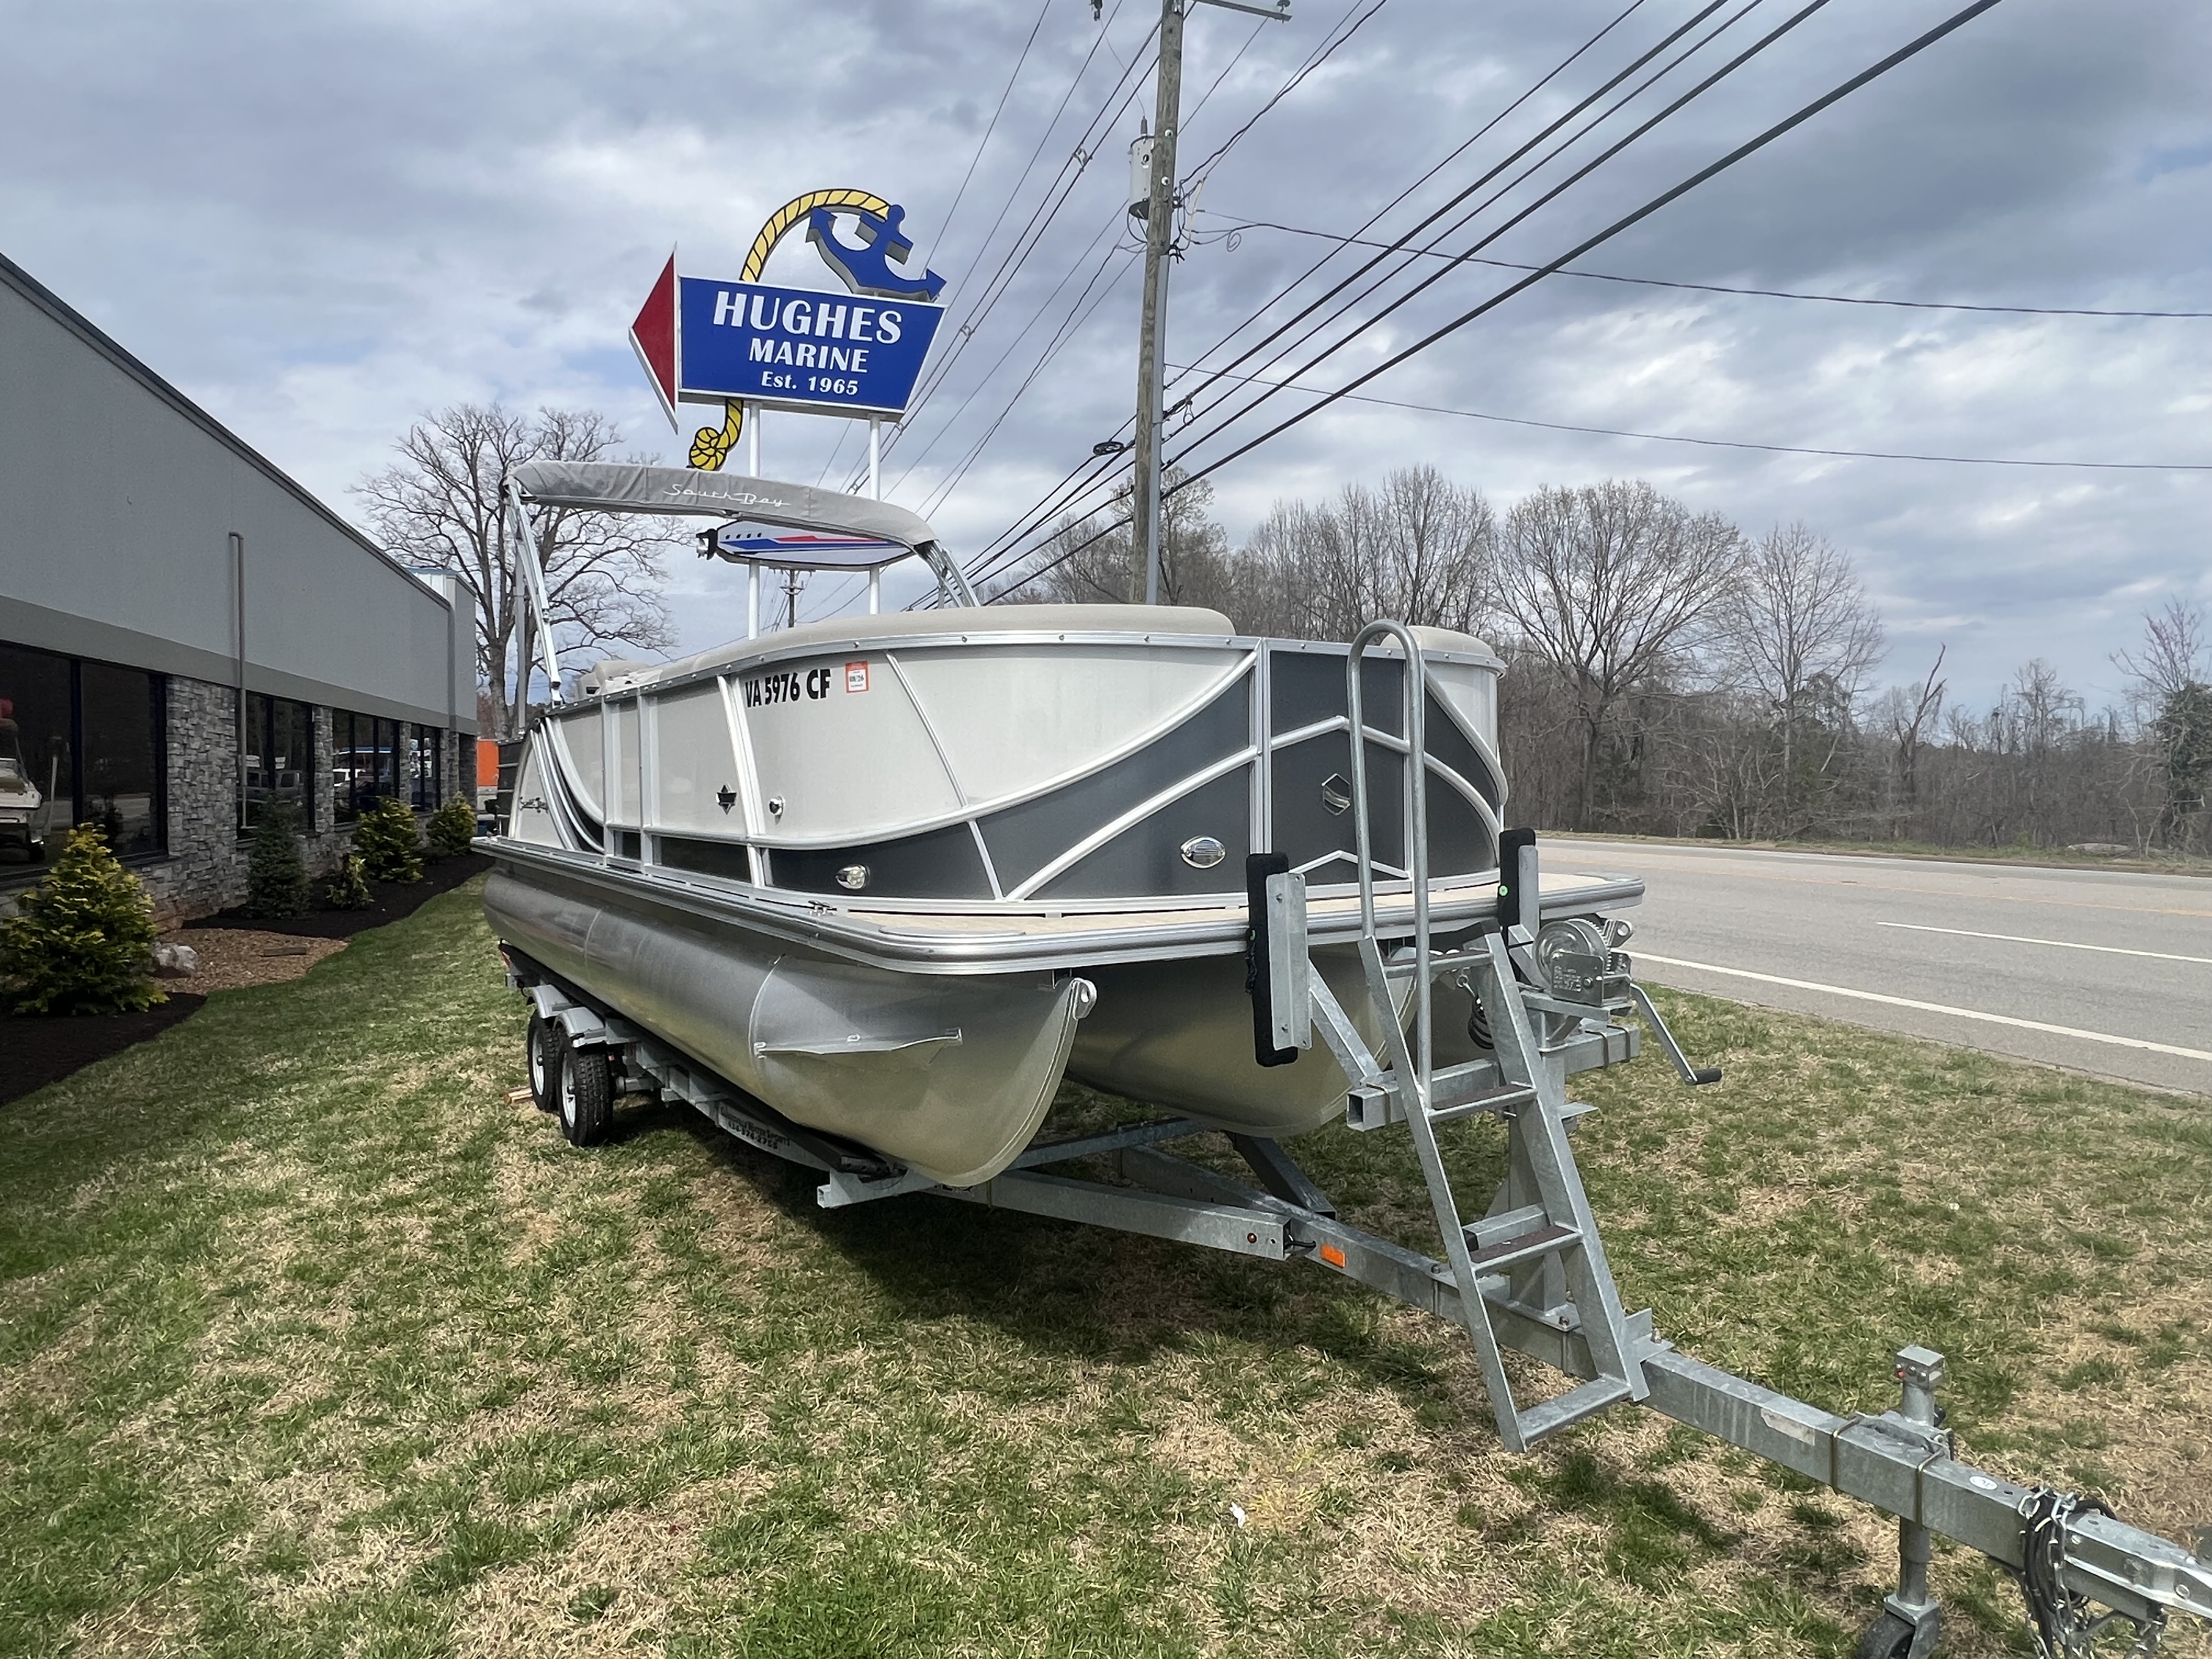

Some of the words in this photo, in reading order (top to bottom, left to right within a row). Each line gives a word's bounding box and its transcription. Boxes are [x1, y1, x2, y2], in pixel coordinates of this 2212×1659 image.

[713, 291, 902, 345] HUGHES
[749, 337, 870, 373] MARINE
[761, 371, 797, 390] Est.
[808, 376, 859, 396] 1965
[663, 484, 736, 500] South
[734, 493, 791, 507] Bay
[746, 679, 762, 708] VA
[765, 672, 800, 706] 5976
[806, 669, 832, 699] CF
